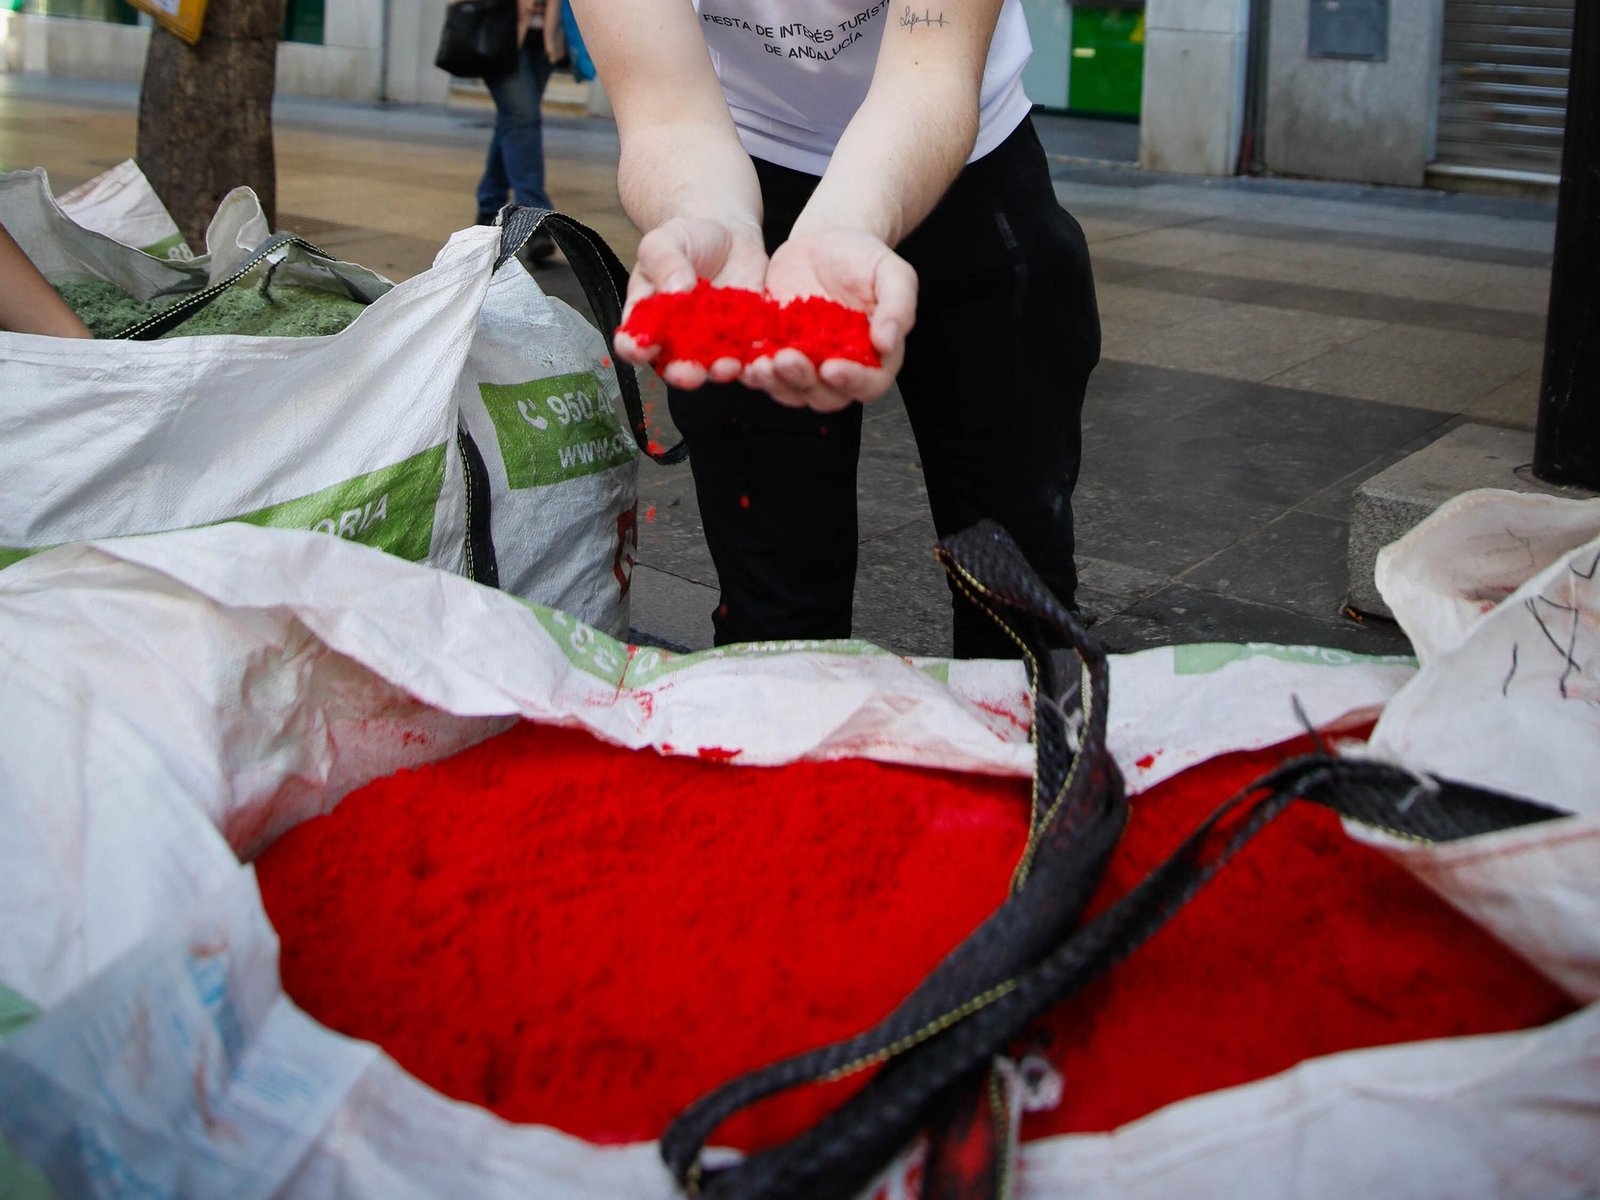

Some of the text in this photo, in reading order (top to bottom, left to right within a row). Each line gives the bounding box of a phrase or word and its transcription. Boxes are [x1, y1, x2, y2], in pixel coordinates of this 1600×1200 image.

[703, 13, 752, 32] FIESTA
[756, 24, 774, 39] DE
[780, 23, 835, 43] INTERÉS
[764, 31, 863, 62] DE ANDALUCÍA
[546, 389, 594, 426] 950
